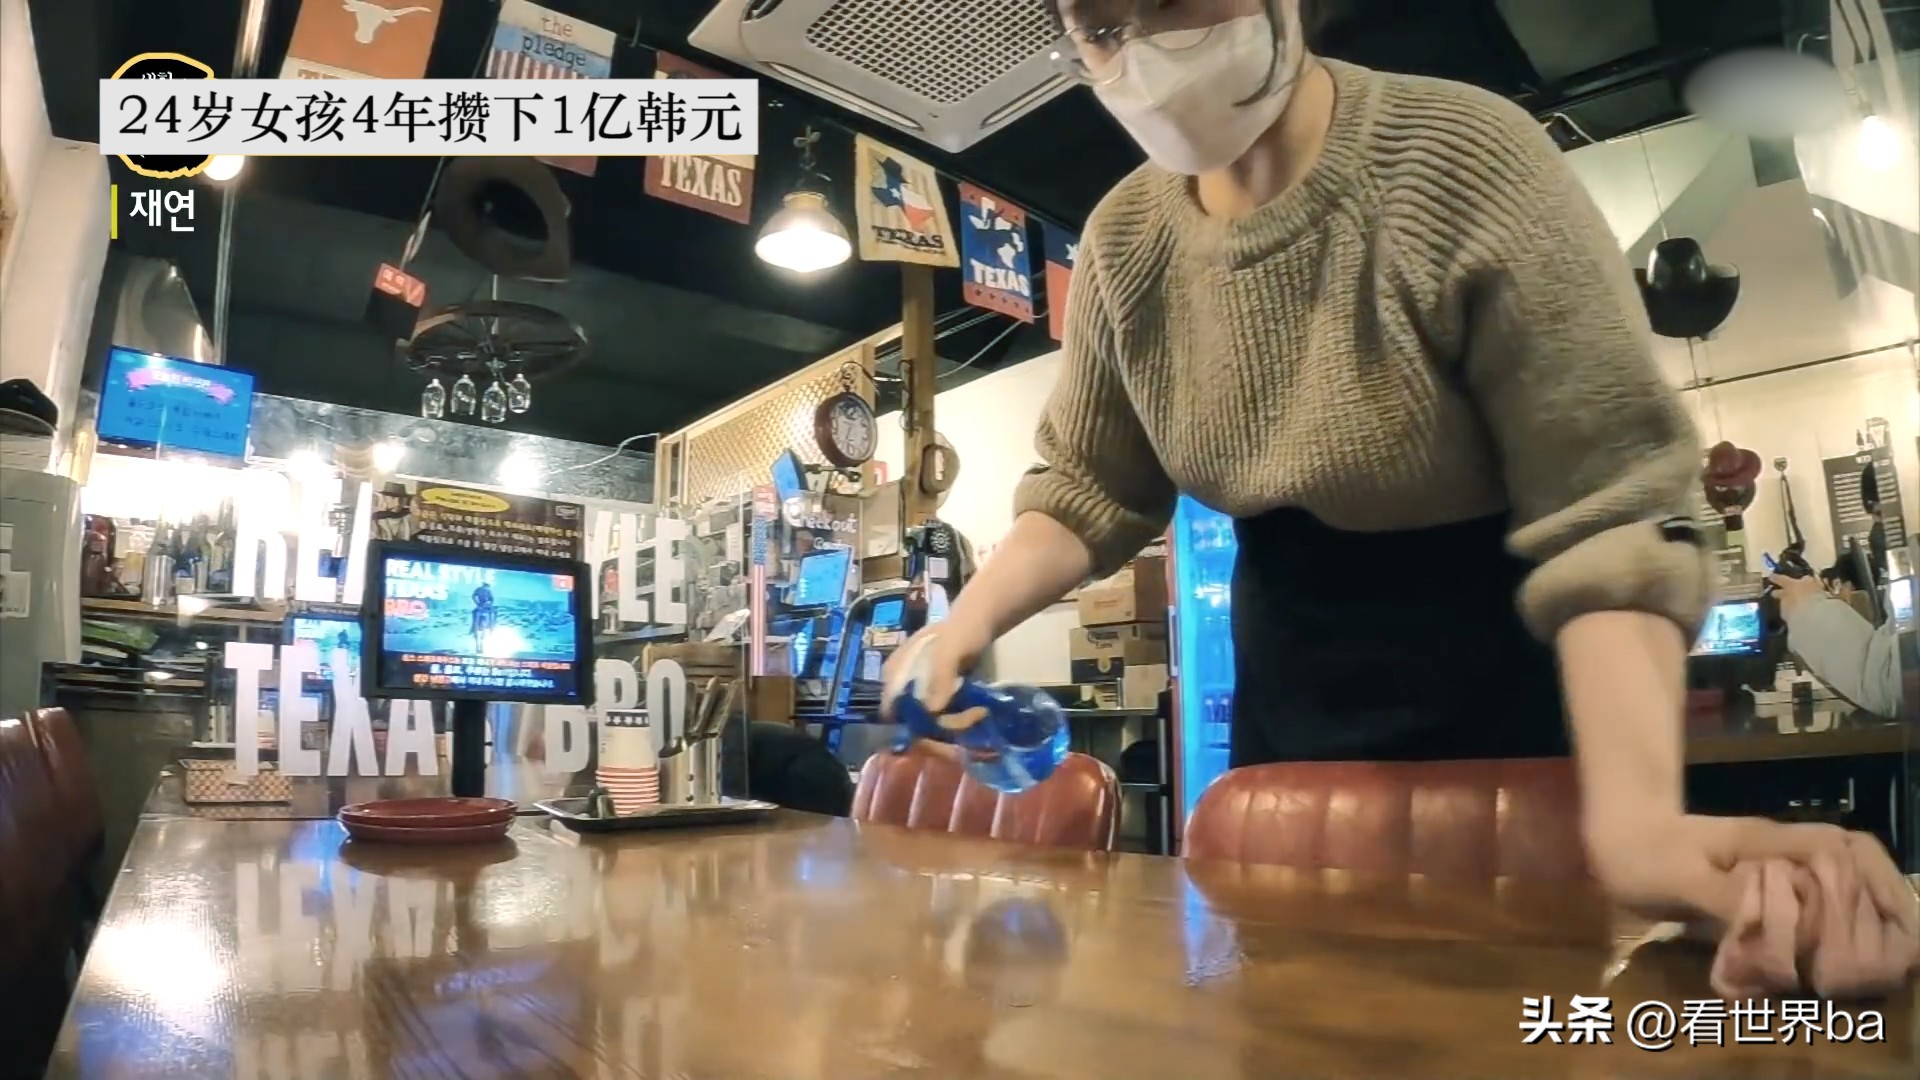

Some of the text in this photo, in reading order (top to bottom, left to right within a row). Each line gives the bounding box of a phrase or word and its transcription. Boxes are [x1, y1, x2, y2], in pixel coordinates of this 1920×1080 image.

[540, 16, 573, 37] the
[521, 35, 586, 69] pledge
[659, 155, 742, 207] TEXAS
[872, 225, 944, 250] TEXAS
[969, 257, 1030, 297] TEXAS
[386, 558, 496, 584] REAL STYLE
